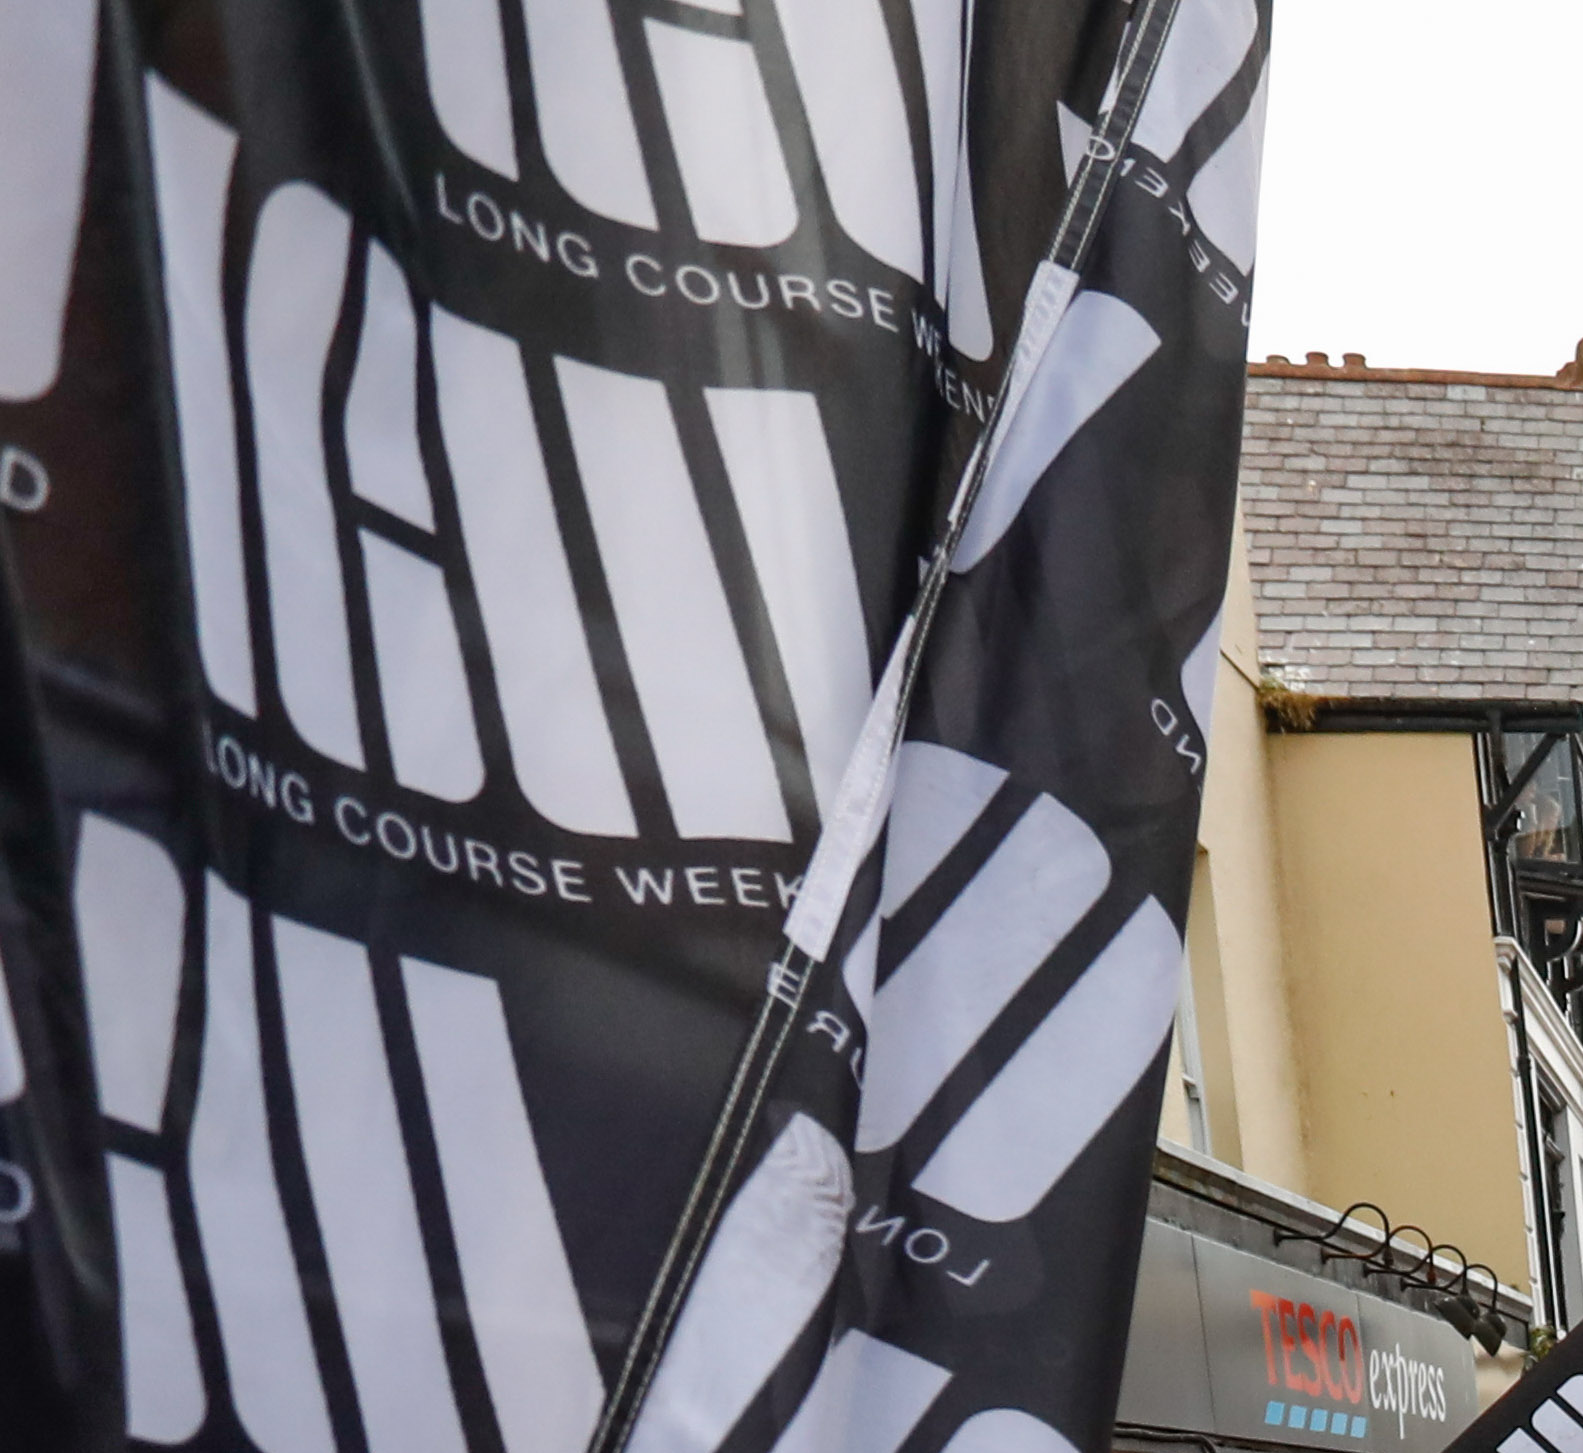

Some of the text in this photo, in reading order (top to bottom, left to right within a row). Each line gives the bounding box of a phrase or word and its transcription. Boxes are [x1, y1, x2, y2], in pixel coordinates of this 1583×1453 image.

[436, 172, 599, 279] LONG
[624, 253, 900, 336] COURSE
[201, 717, 810, 913] LONG COURSE WEEK
[1250, 1288, 1446, 1439] TESCO express
